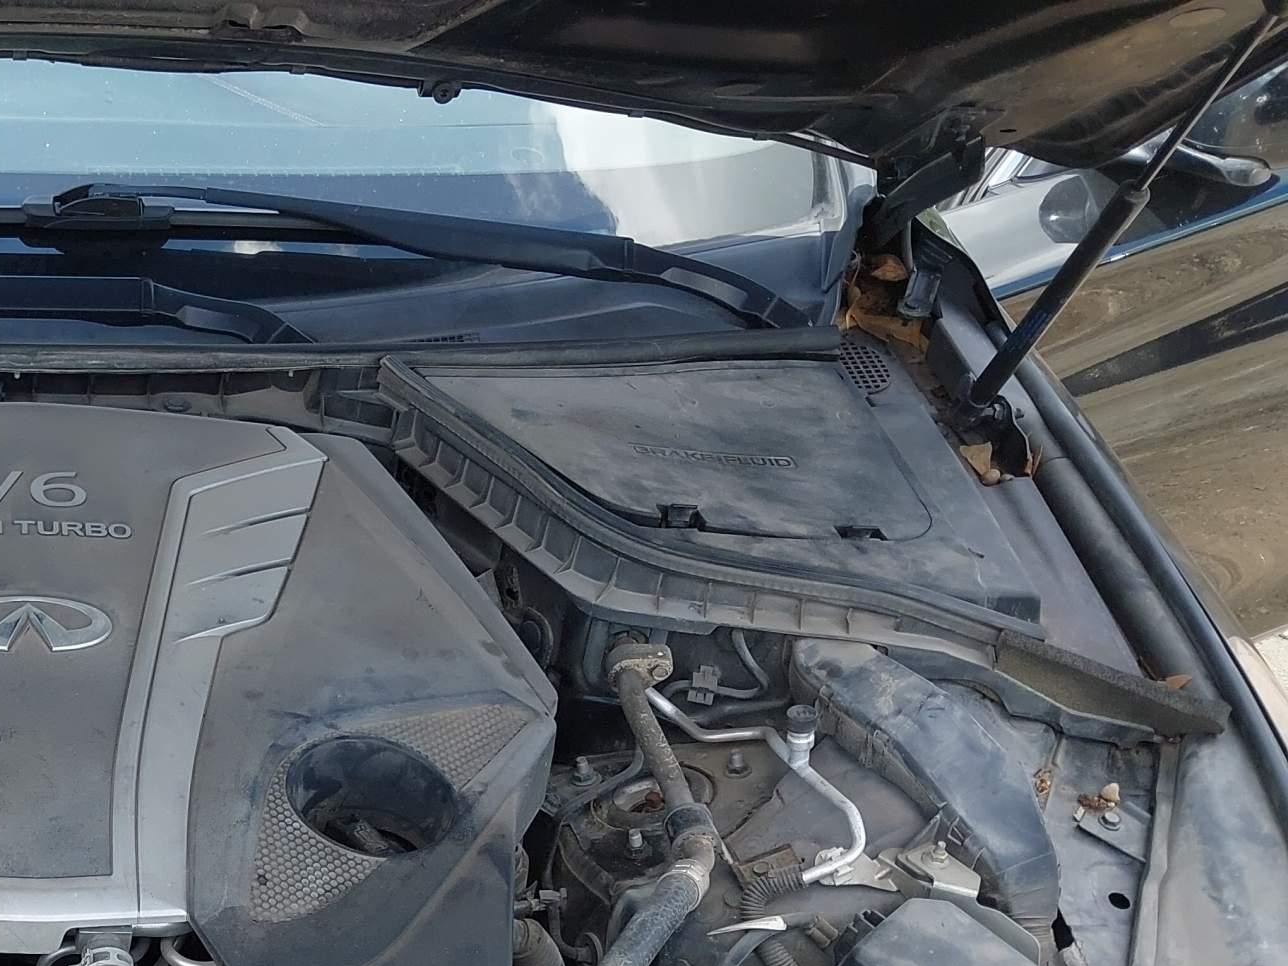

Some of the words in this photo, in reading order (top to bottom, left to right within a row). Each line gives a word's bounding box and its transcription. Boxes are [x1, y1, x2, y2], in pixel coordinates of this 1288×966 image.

[633, 445, 711, 462] BRAKE
[723, 455, 794, 468] FLUID
[13, 519, 133, 540] TURBO
